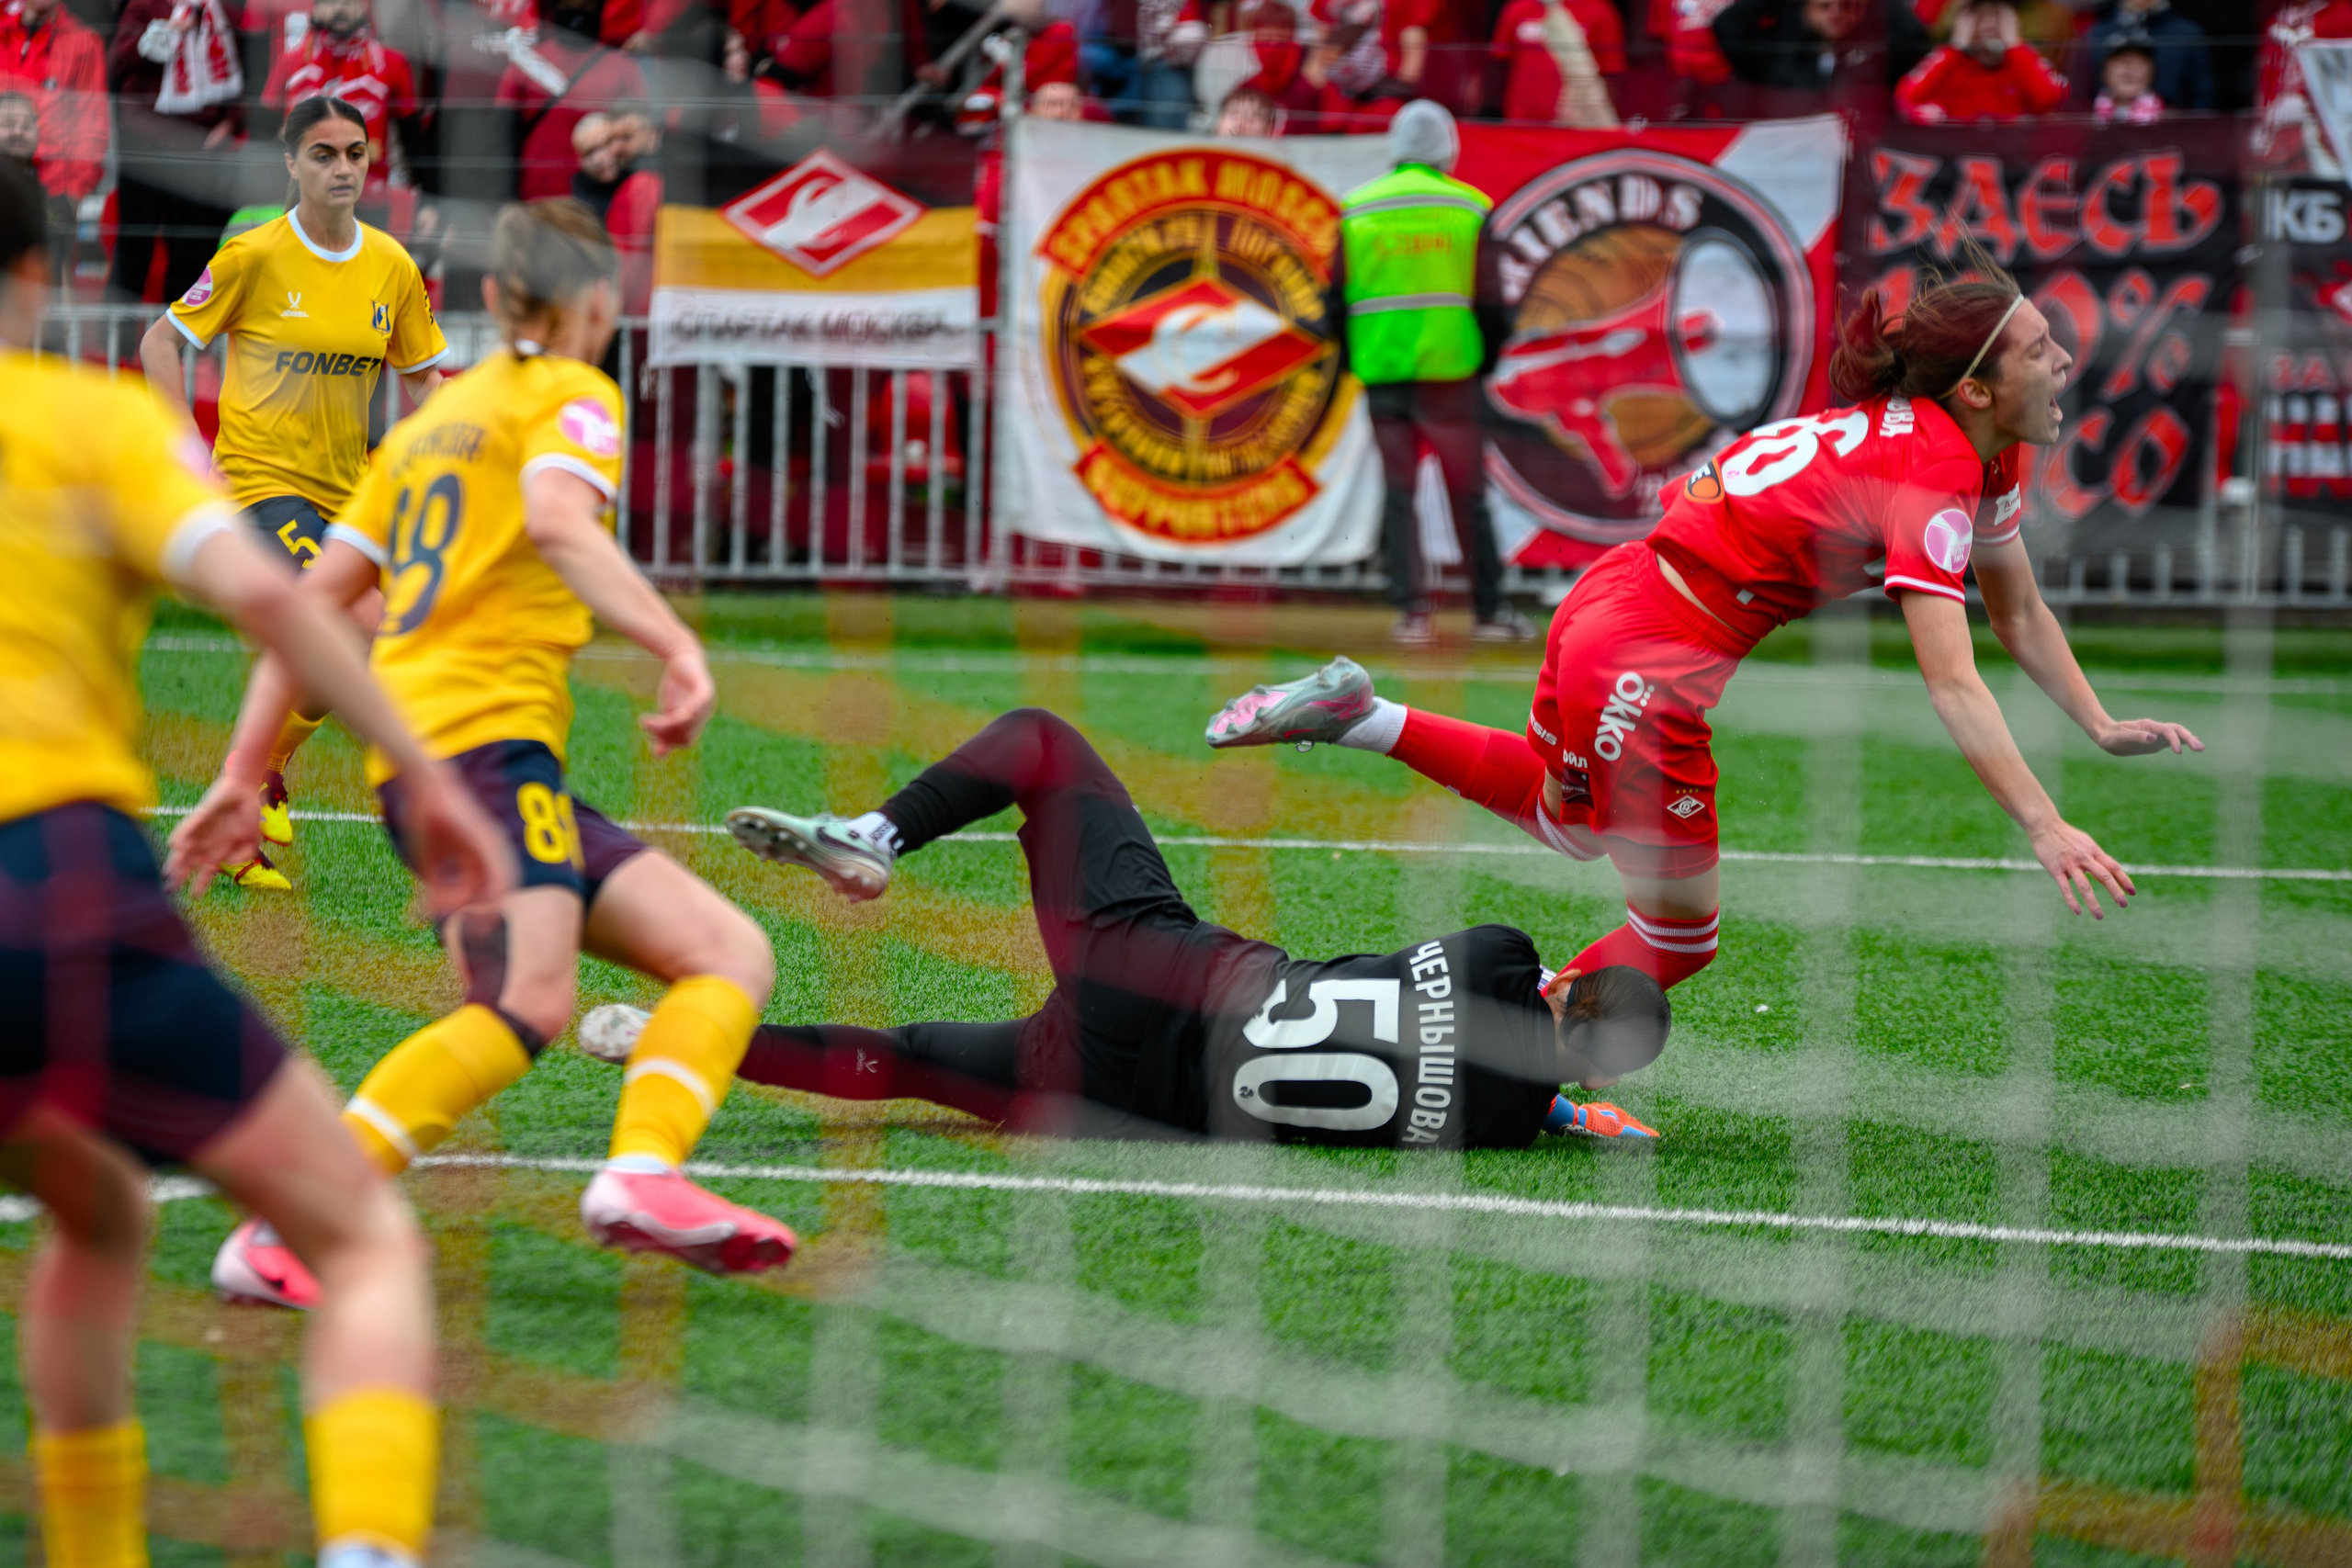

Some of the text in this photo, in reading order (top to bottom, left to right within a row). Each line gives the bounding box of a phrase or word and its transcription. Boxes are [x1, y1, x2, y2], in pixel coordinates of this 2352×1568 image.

[275, 351, 382, 378] FONBET
[1722, 411, 1870, 497] 6
[1880, 396, 1916, 438] ОВА
[2018, 406, 2191, 522] СО
[277, 519, 323, 570] 5
[1233, 978, 1401, 1131] 50
[1401, 941, 1456, 1145] ЧЕРНЫШОВА
